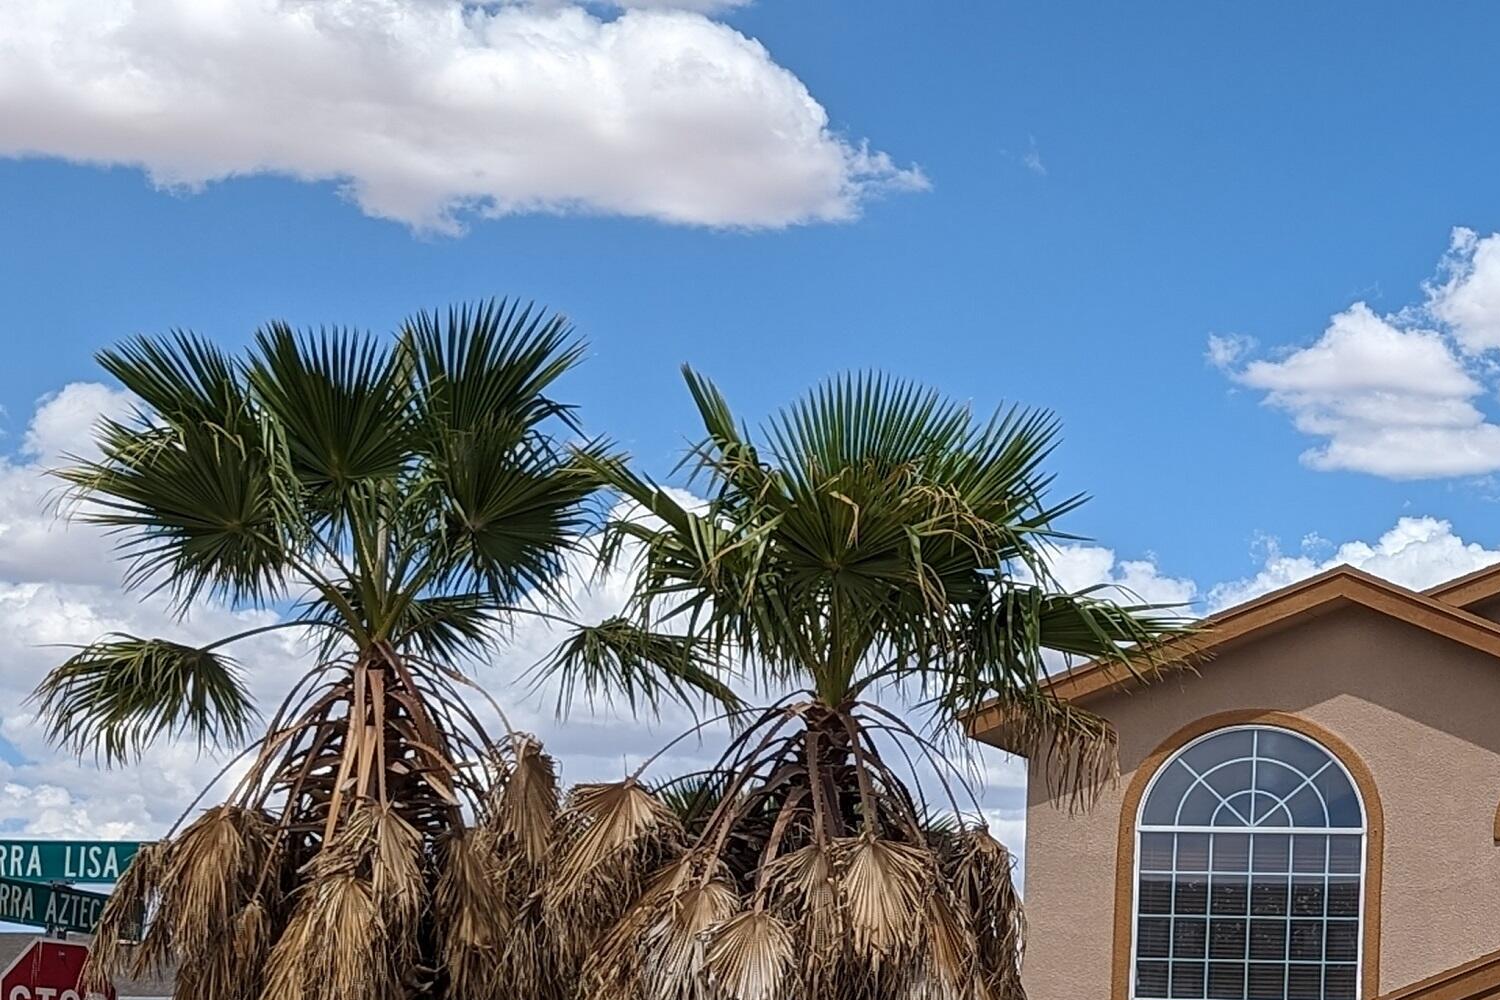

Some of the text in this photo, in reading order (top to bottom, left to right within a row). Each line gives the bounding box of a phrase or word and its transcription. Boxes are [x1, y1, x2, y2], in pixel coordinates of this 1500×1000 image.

[64, 846, 119, 878] LISA
[0, 883, 108, 930] RRA AZTEC
